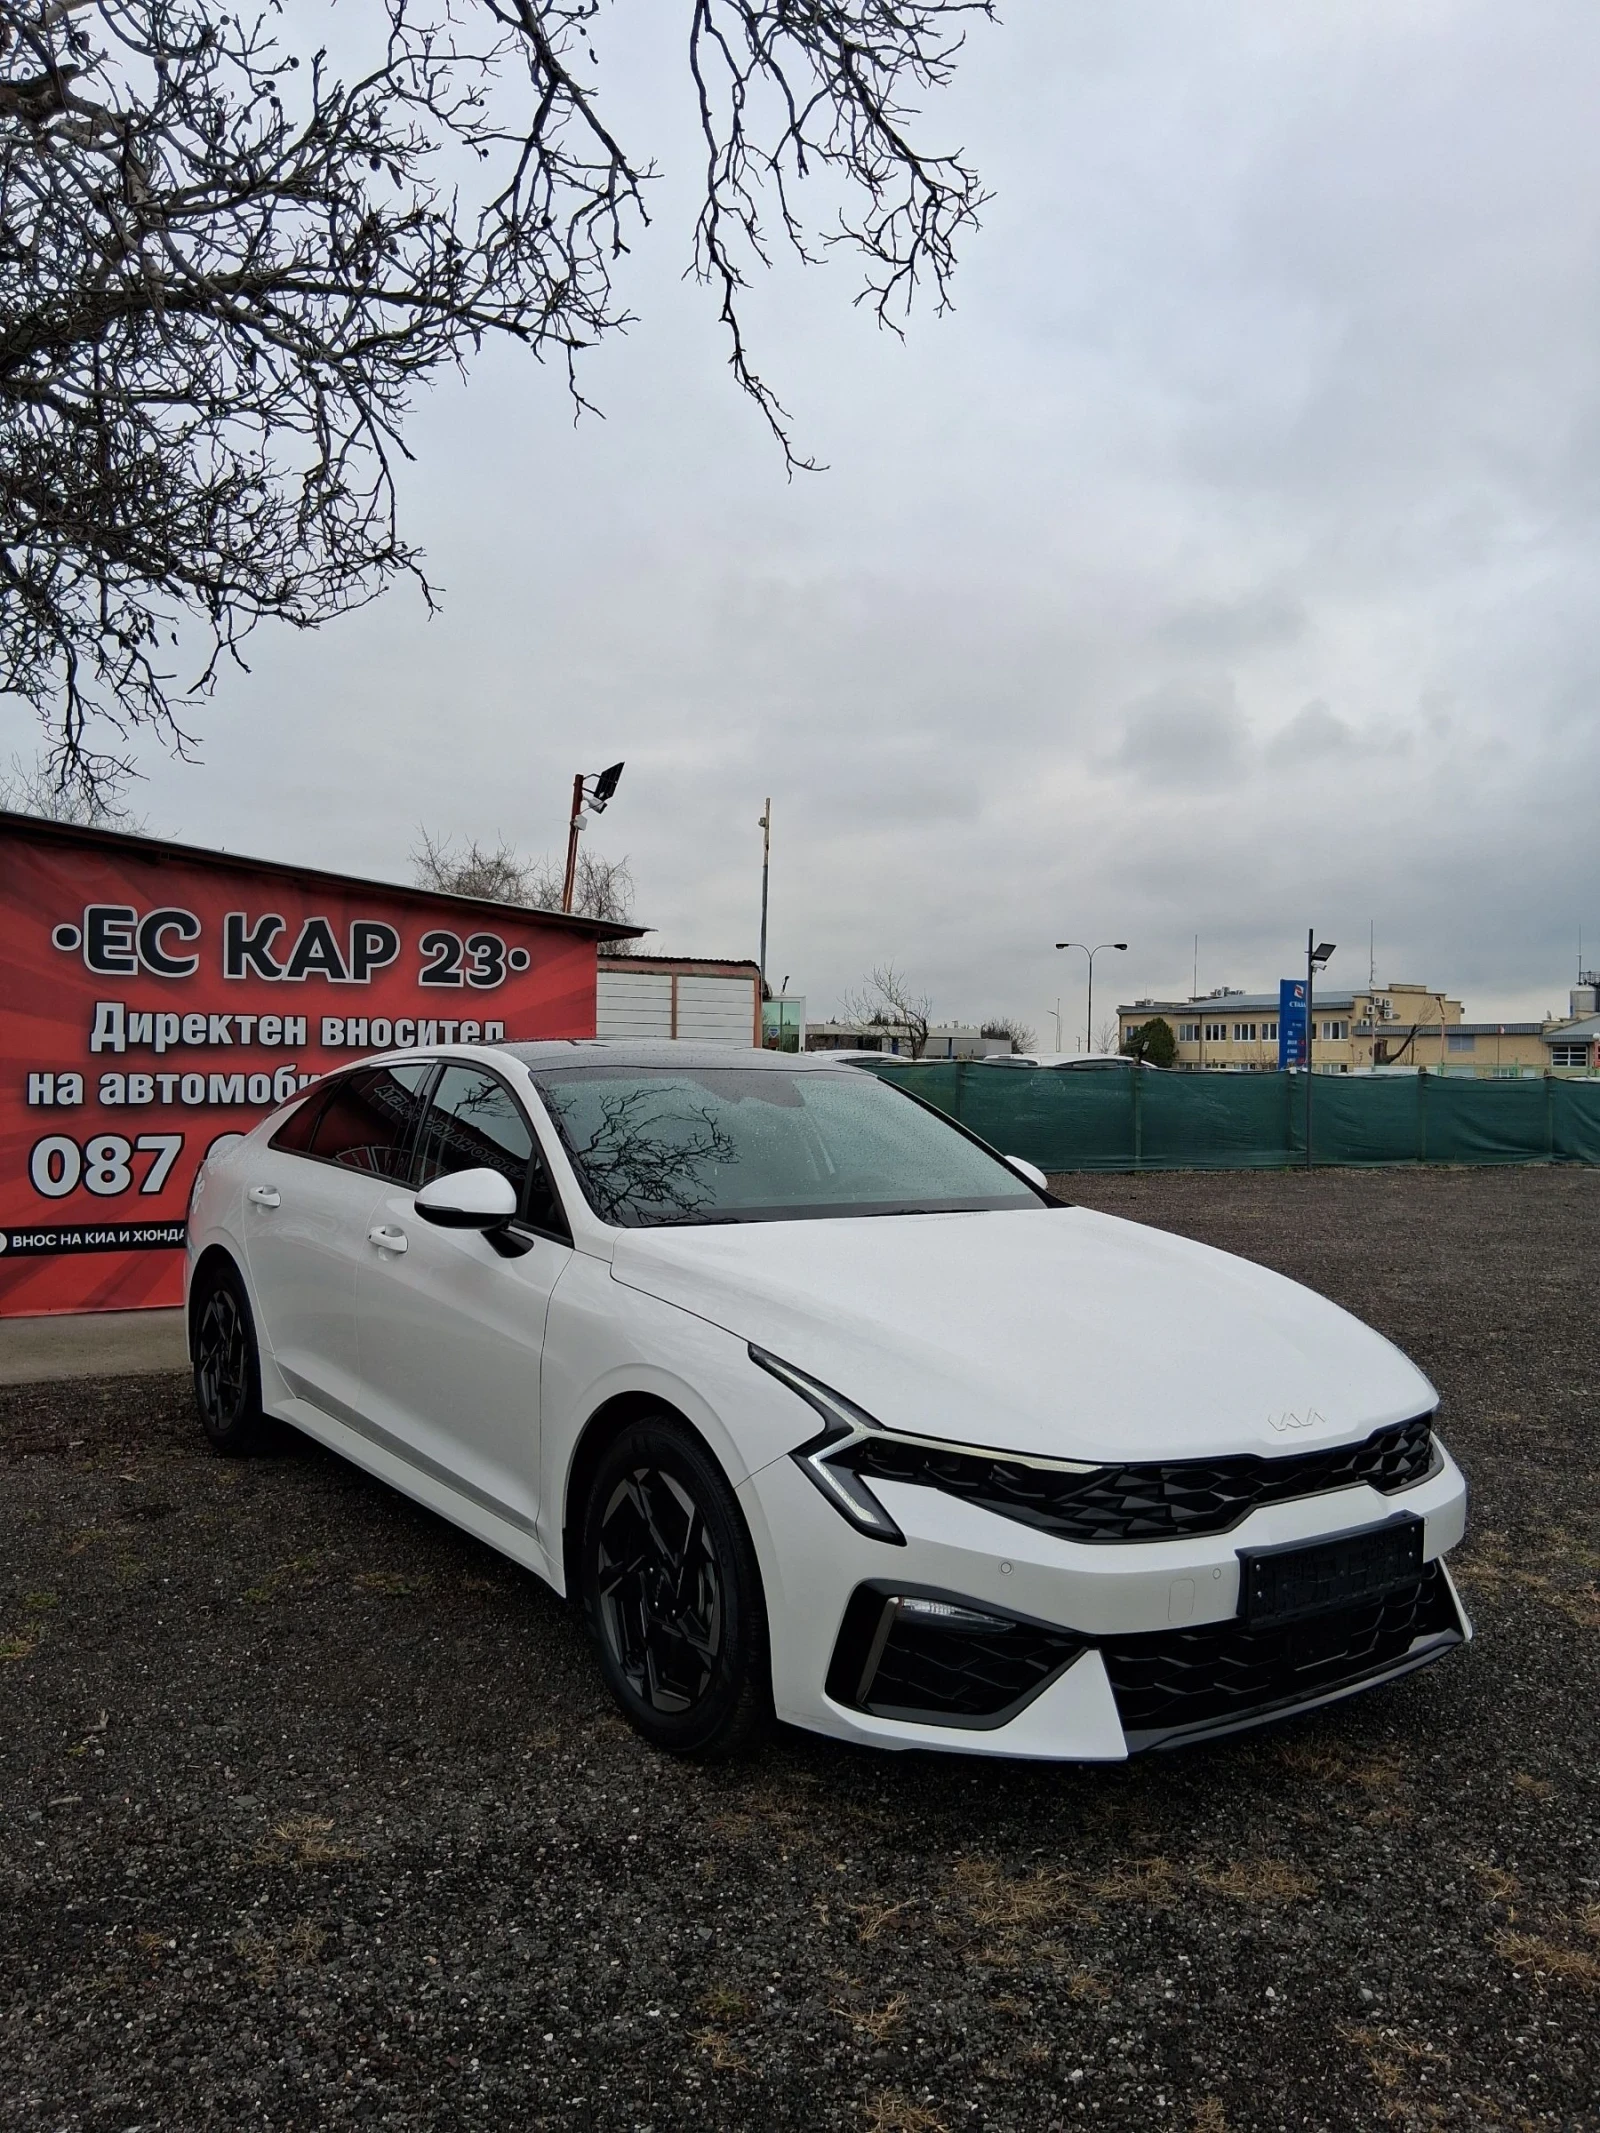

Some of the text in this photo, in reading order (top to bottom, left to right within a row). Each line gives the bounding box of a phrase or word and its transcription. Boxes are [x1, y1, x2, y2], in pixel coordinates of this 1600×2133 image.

[224, 912, 400, 984] КАР
[90, 1000, 308, 1053] Директен
[27, 1072, 85, 1105] на
[28, 1133, 185, 1199] 087
[12, 1233, 57, 1248] ВНОС
[60, 1231, 82, 1245] НА
[84, 1231, 116, 1244] КИА
[119, 1230, 130, 1242] И
